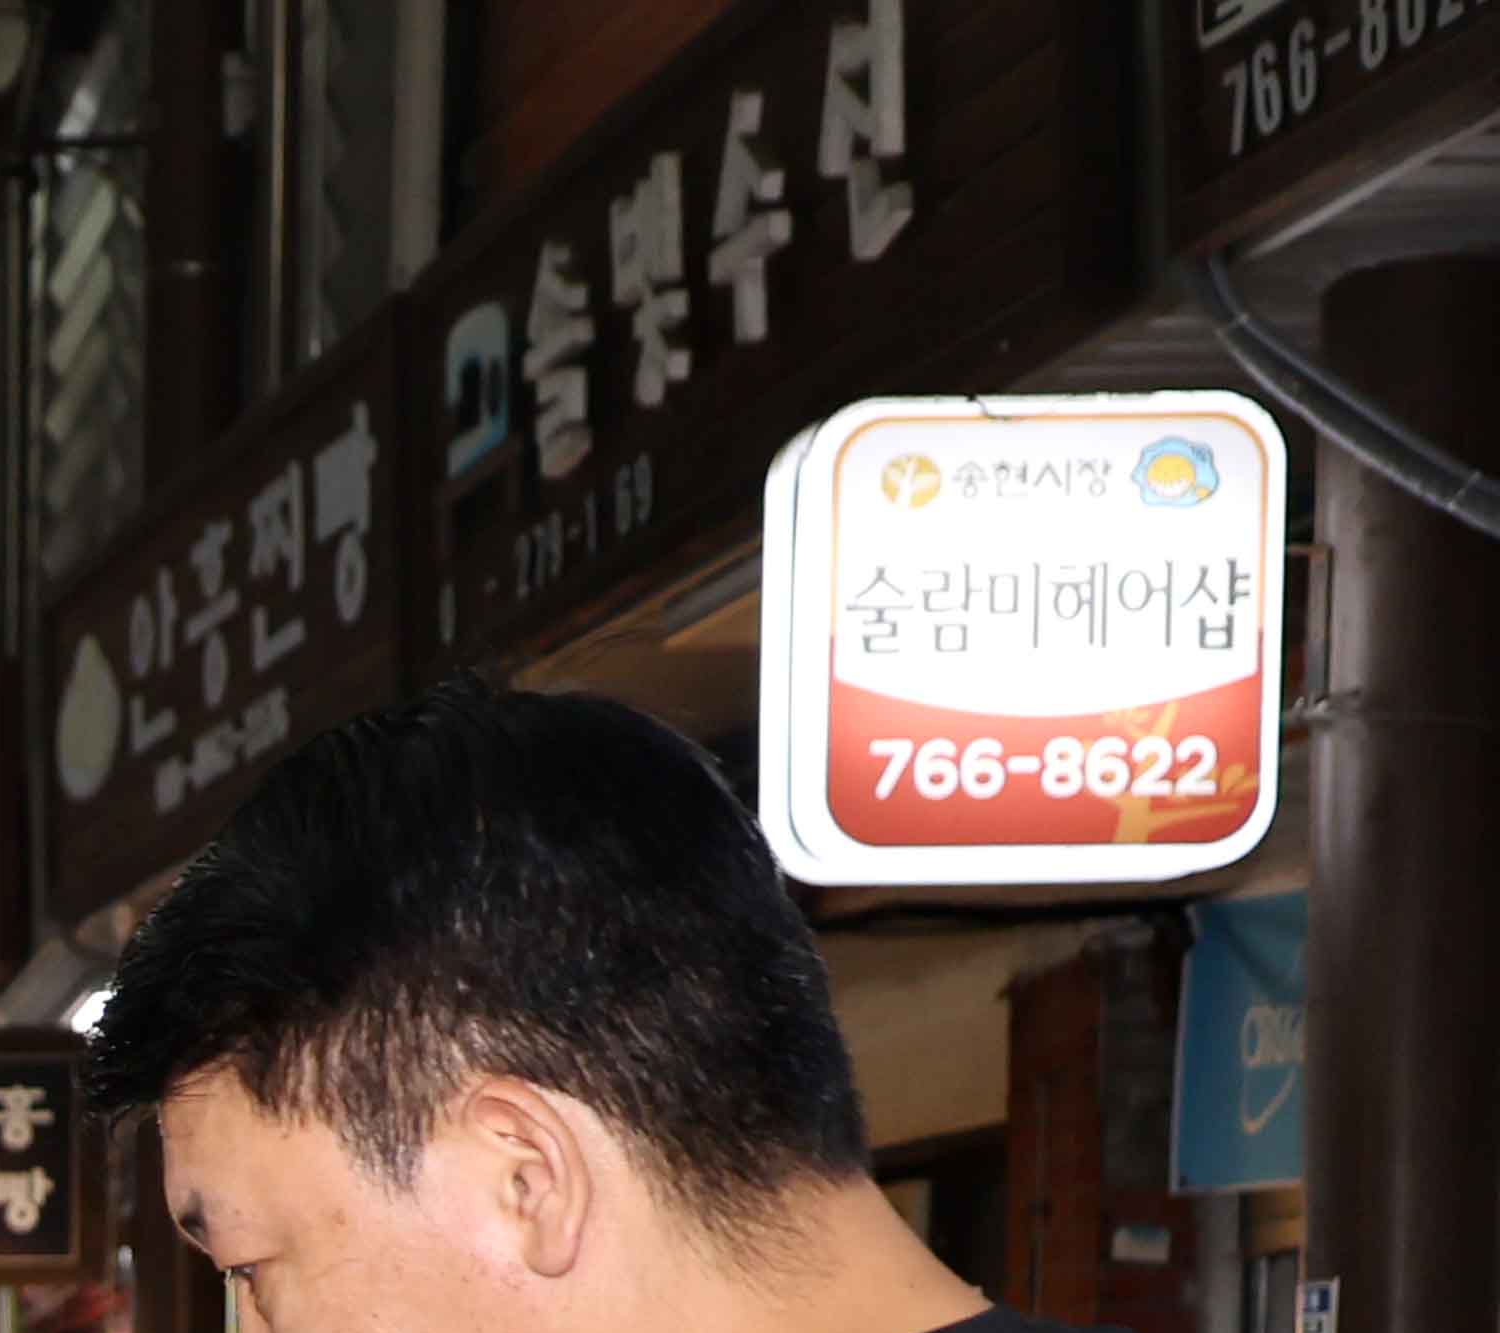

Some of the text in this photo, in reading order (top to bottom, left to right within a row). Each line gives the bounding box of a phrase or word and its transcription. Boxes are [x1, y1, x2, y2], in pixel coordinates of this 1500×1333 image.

[1221, 0, 1492, 156] 766-8
[953, 459, 1113, 499] 송현시장
[128, 400, 379, 758] 안흥찐빵
[845, 556, 1252, 654] 술람미헤어샵
[868, 735, 1219, 801] 766-8622
